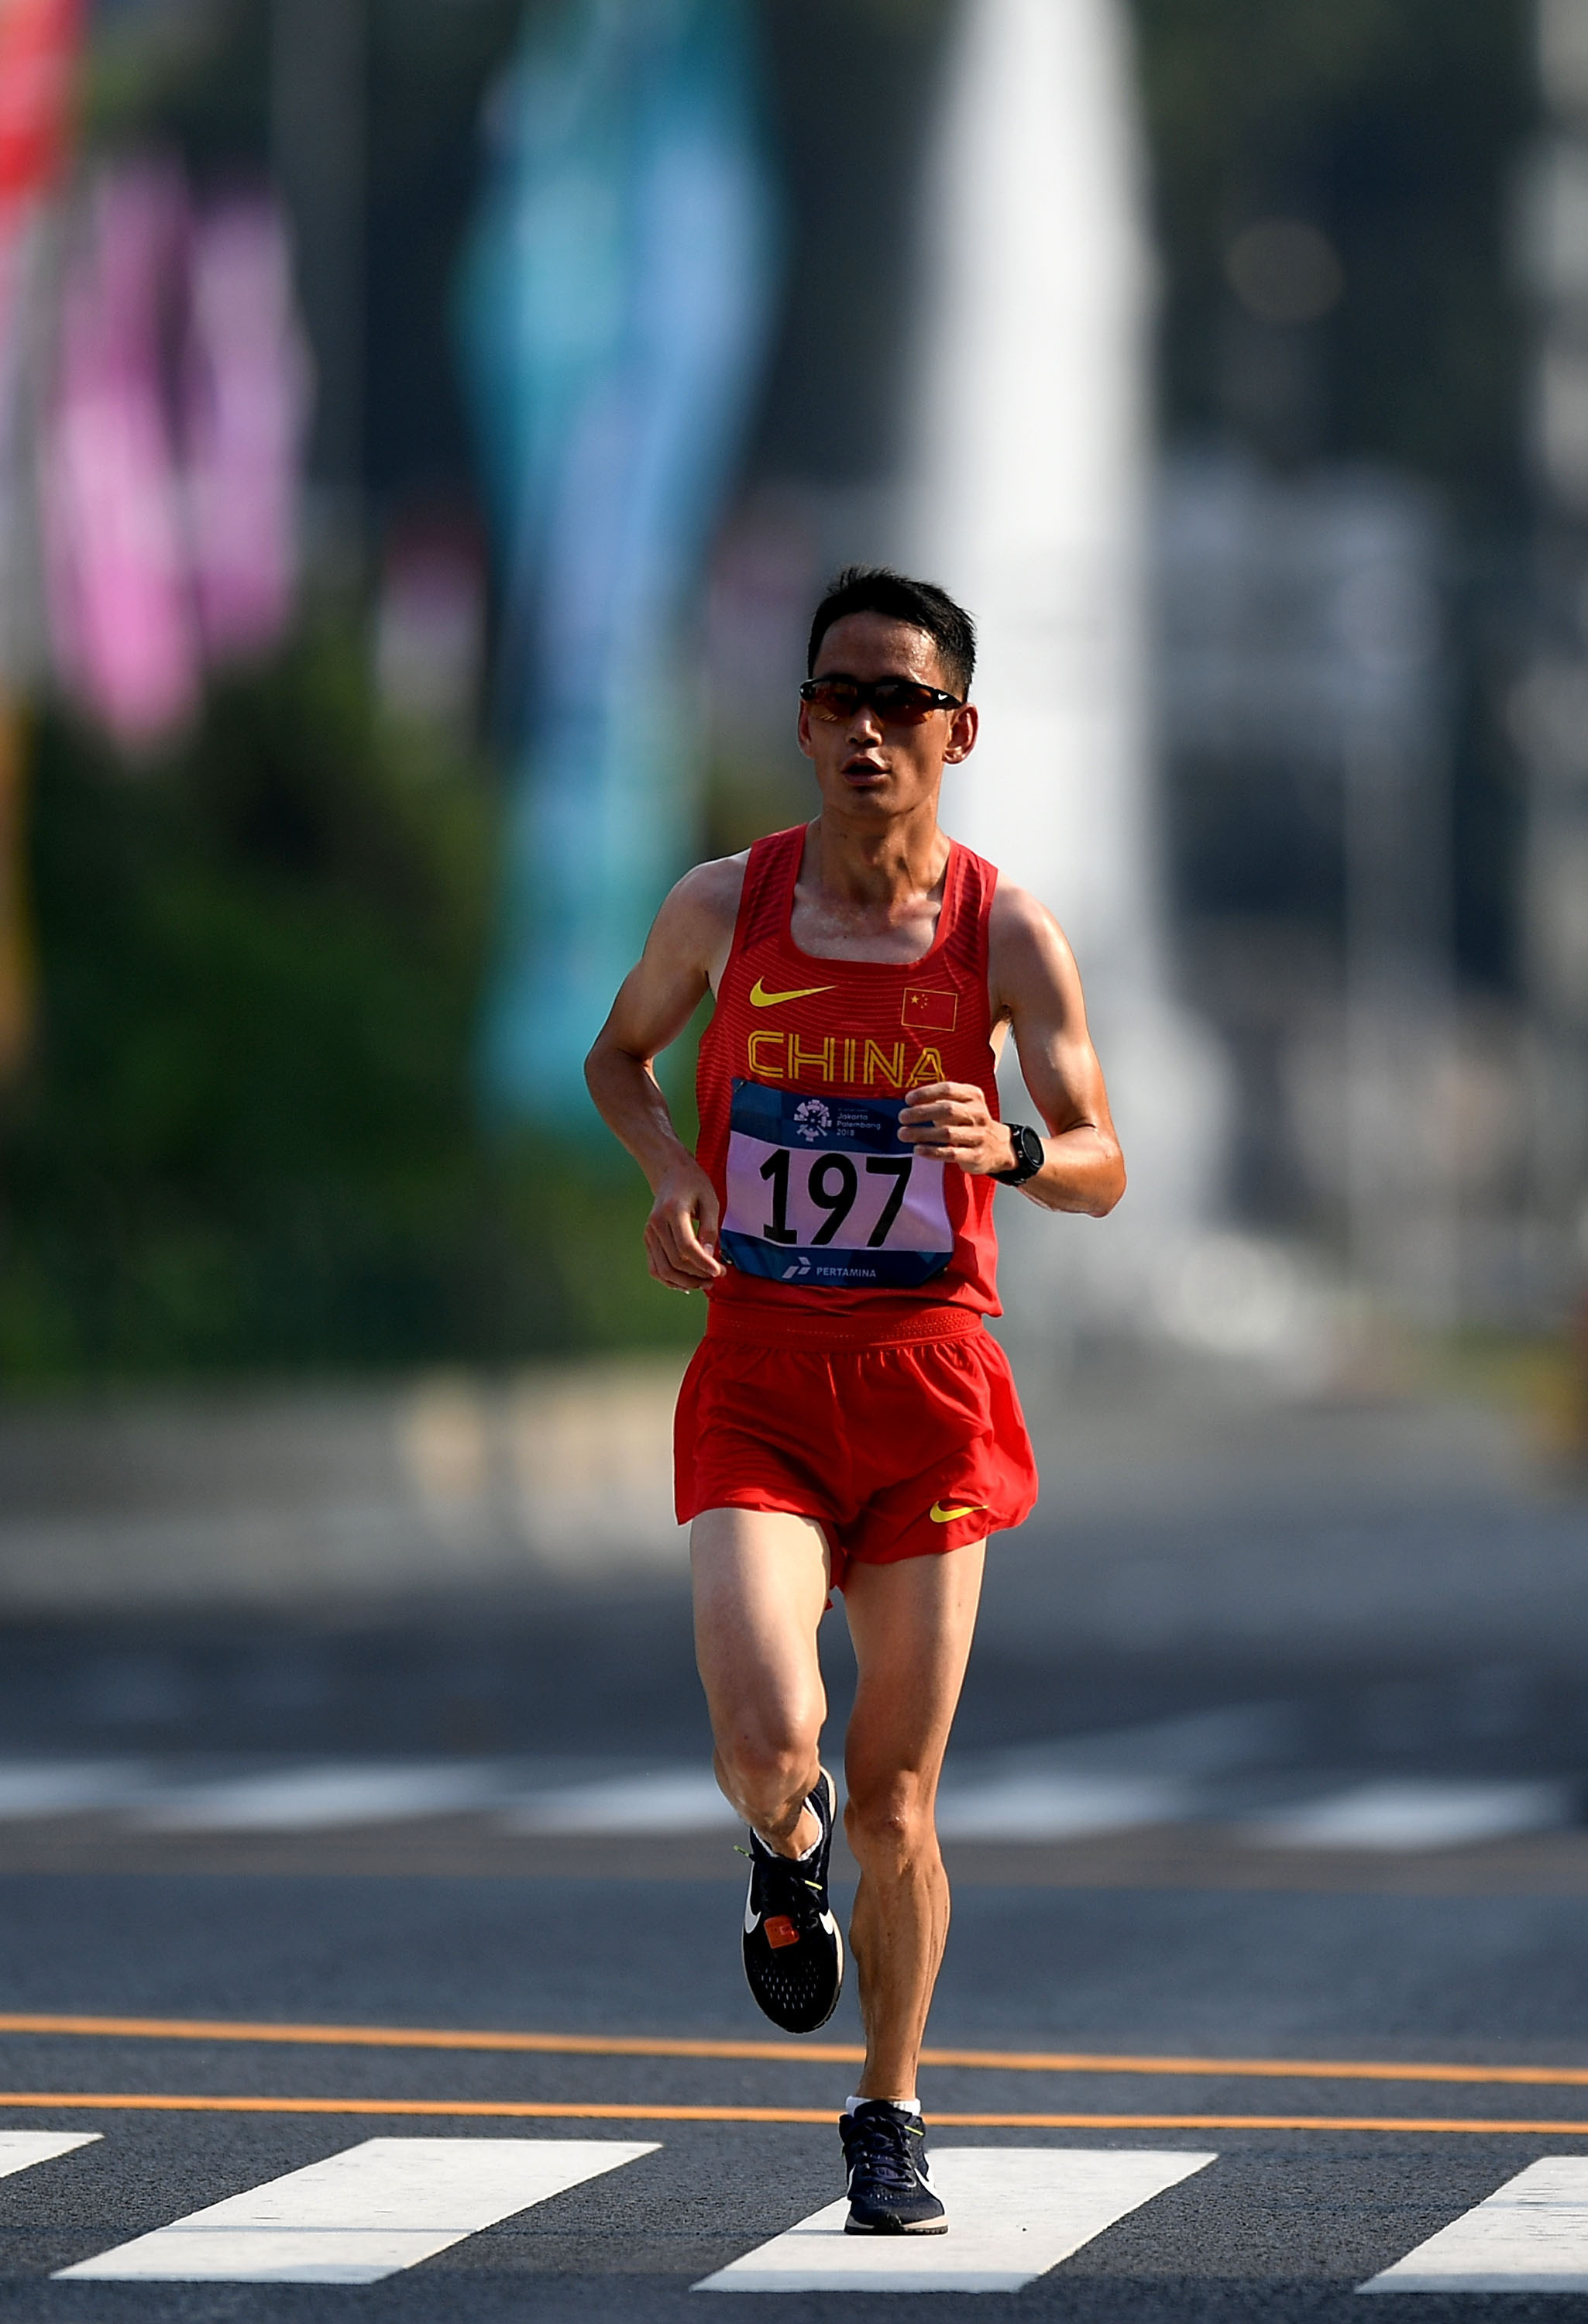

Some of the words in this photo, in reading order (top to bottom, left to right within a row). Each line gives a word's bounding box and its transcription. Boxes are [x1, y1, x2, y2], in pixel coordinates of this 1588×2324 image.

[748, 1030, 946, 1088] CHINA
[837, 1120, 881, 1130] Palembang
[759, 1148, 913, 1248] 197
[816, 1267, 876, 1277] PERTAMINA
